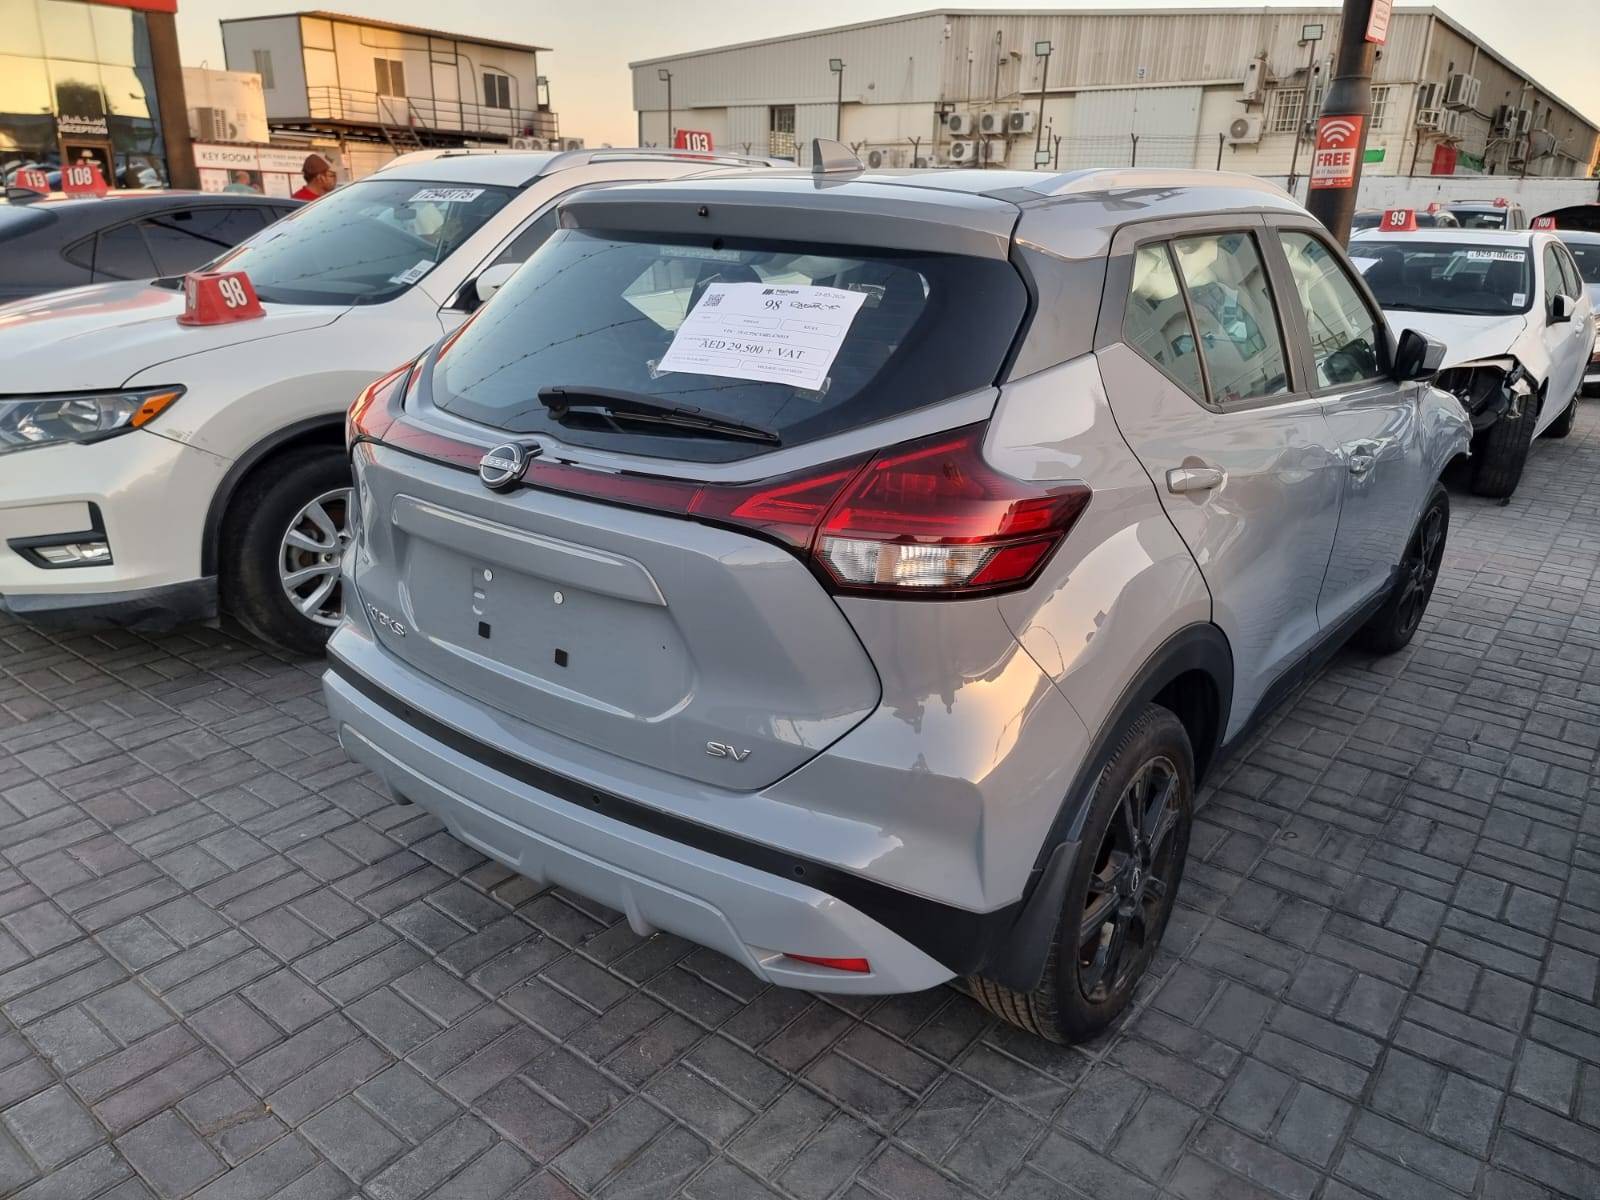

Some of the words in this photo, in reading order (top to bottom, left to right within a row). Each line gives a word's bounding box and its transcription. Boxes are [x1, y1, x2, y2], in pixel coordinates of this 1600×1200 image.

[684, 132, 709, 151] 103
[201, 151, 219, 161] KEY
[222, 152, 251, 163] ROOM
[1317, 152, 1351, 167] FREE
[67, 166, 93, 187] 108
[1390, 210, 1406, 226] 99
[218, 276, 248, 309] 98
[763, 299, 783, 311] 98
[698, 339, 726, 350] AED
[727, 341, 763, 354] 29,500
[778, 347, 806, 360] VAT
[484, 455, 519, 471] SSAN
[706, 741, 751, 761] SV
